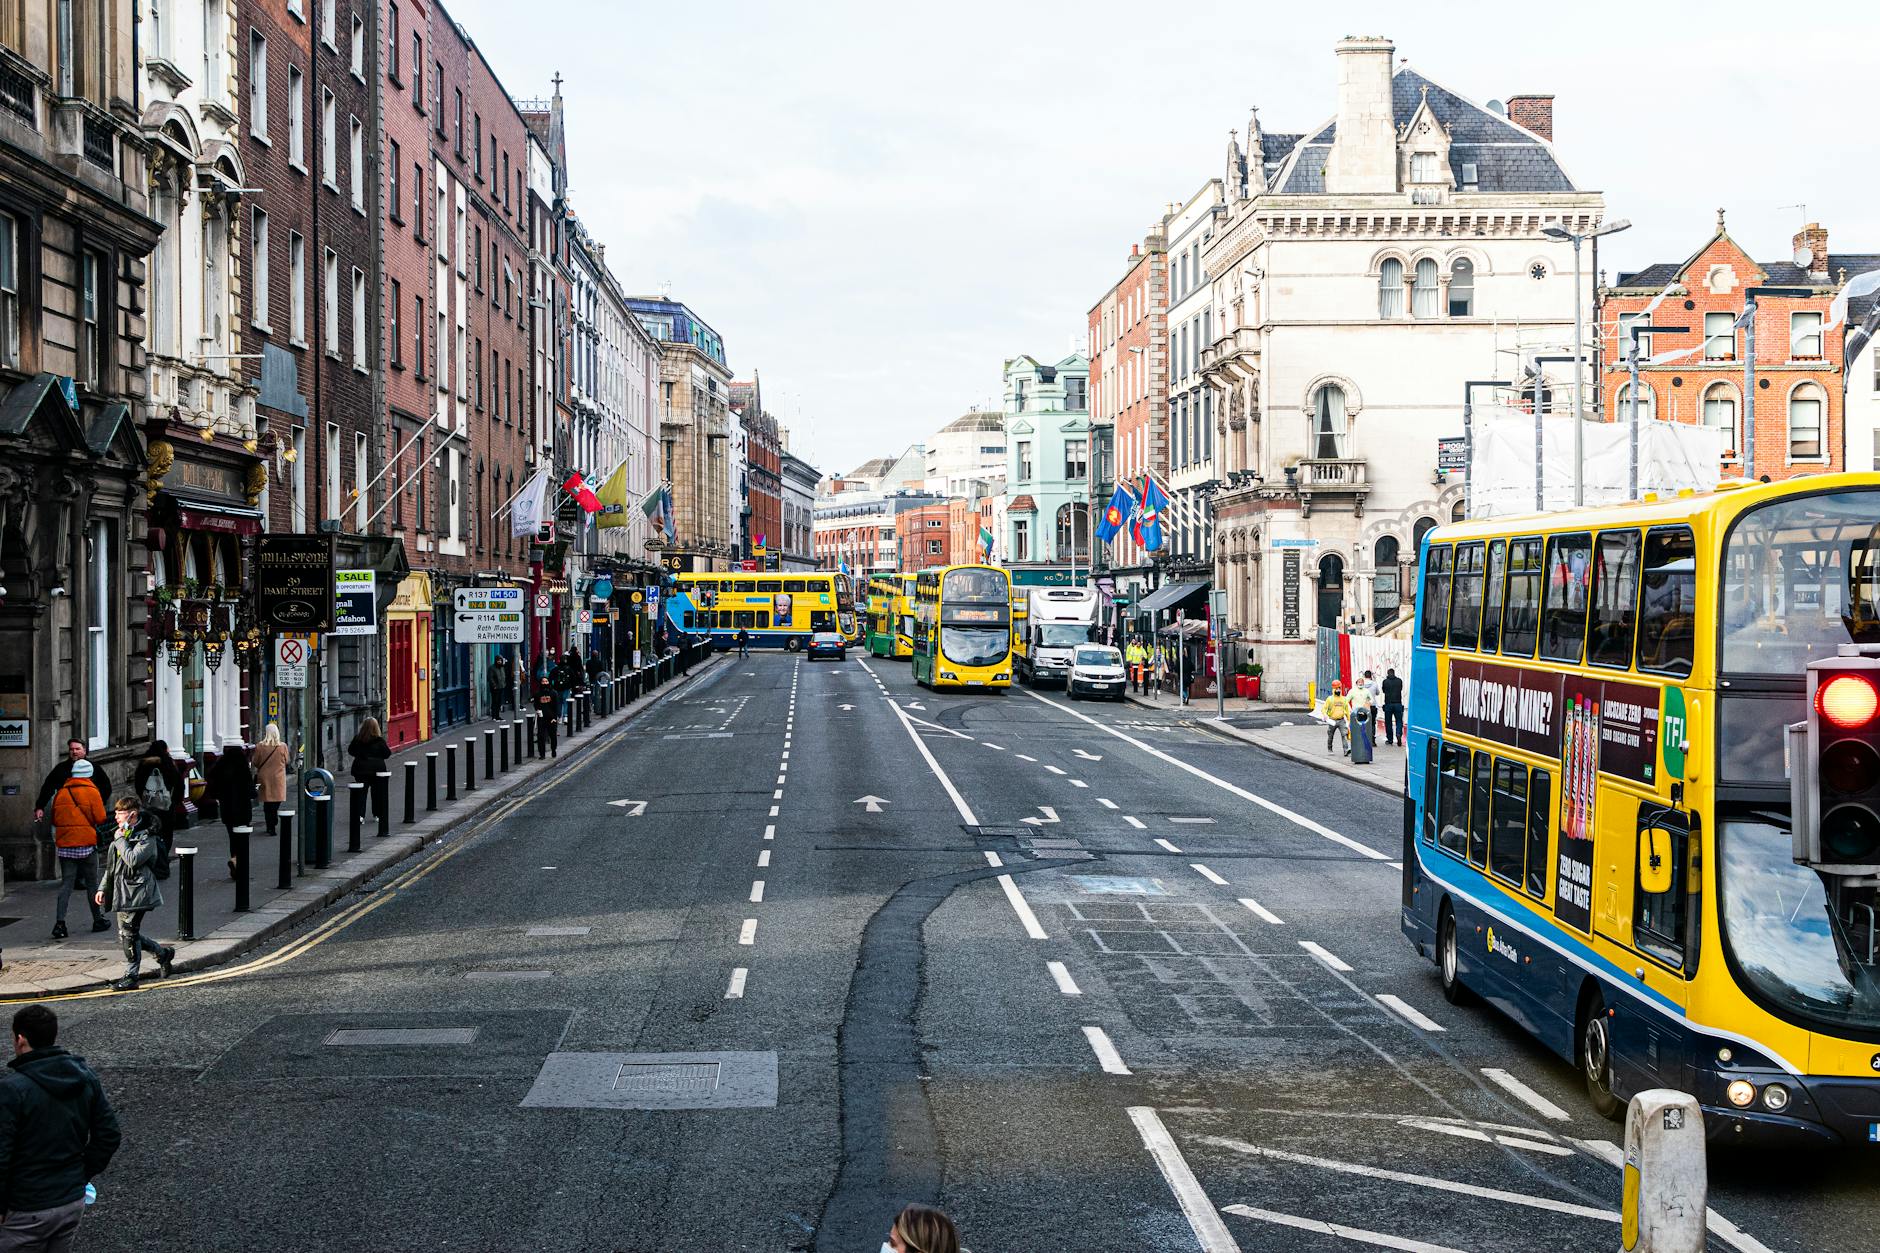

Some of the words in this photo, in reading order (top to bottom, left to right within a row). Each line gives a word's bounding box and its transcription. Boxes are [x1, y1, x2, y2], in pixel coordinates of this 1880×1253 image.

[287, 577, 301, 587] 39
[344, 573, 369, 581] SALE
[264, 587, 288, 596] DAME
[291, 587, 324, 596] STREET
[336, 615, 366, 623] cMahon
[1459, 677, 1479, 719] YOUR
[1480, 680, 1503, 724] STOP
[1504, 684, 1517, 728] OR
[1519, 688, 1553, 736] MINE?
[1604, 700, 1628, 721] LUCOZADE
[1628, 704, 1641, 724] ZERO
[1602, 728, 1612, 741] ZERO
[1627, 733, 1640, 748] GIVEN
[1560, 854, 1571, 879] ZERO
[1572, 859, 1590, 887] SUGAR
[1559, 877, 1574, 902] GREAT
[1574, 884, 1590, 910] TASTE
